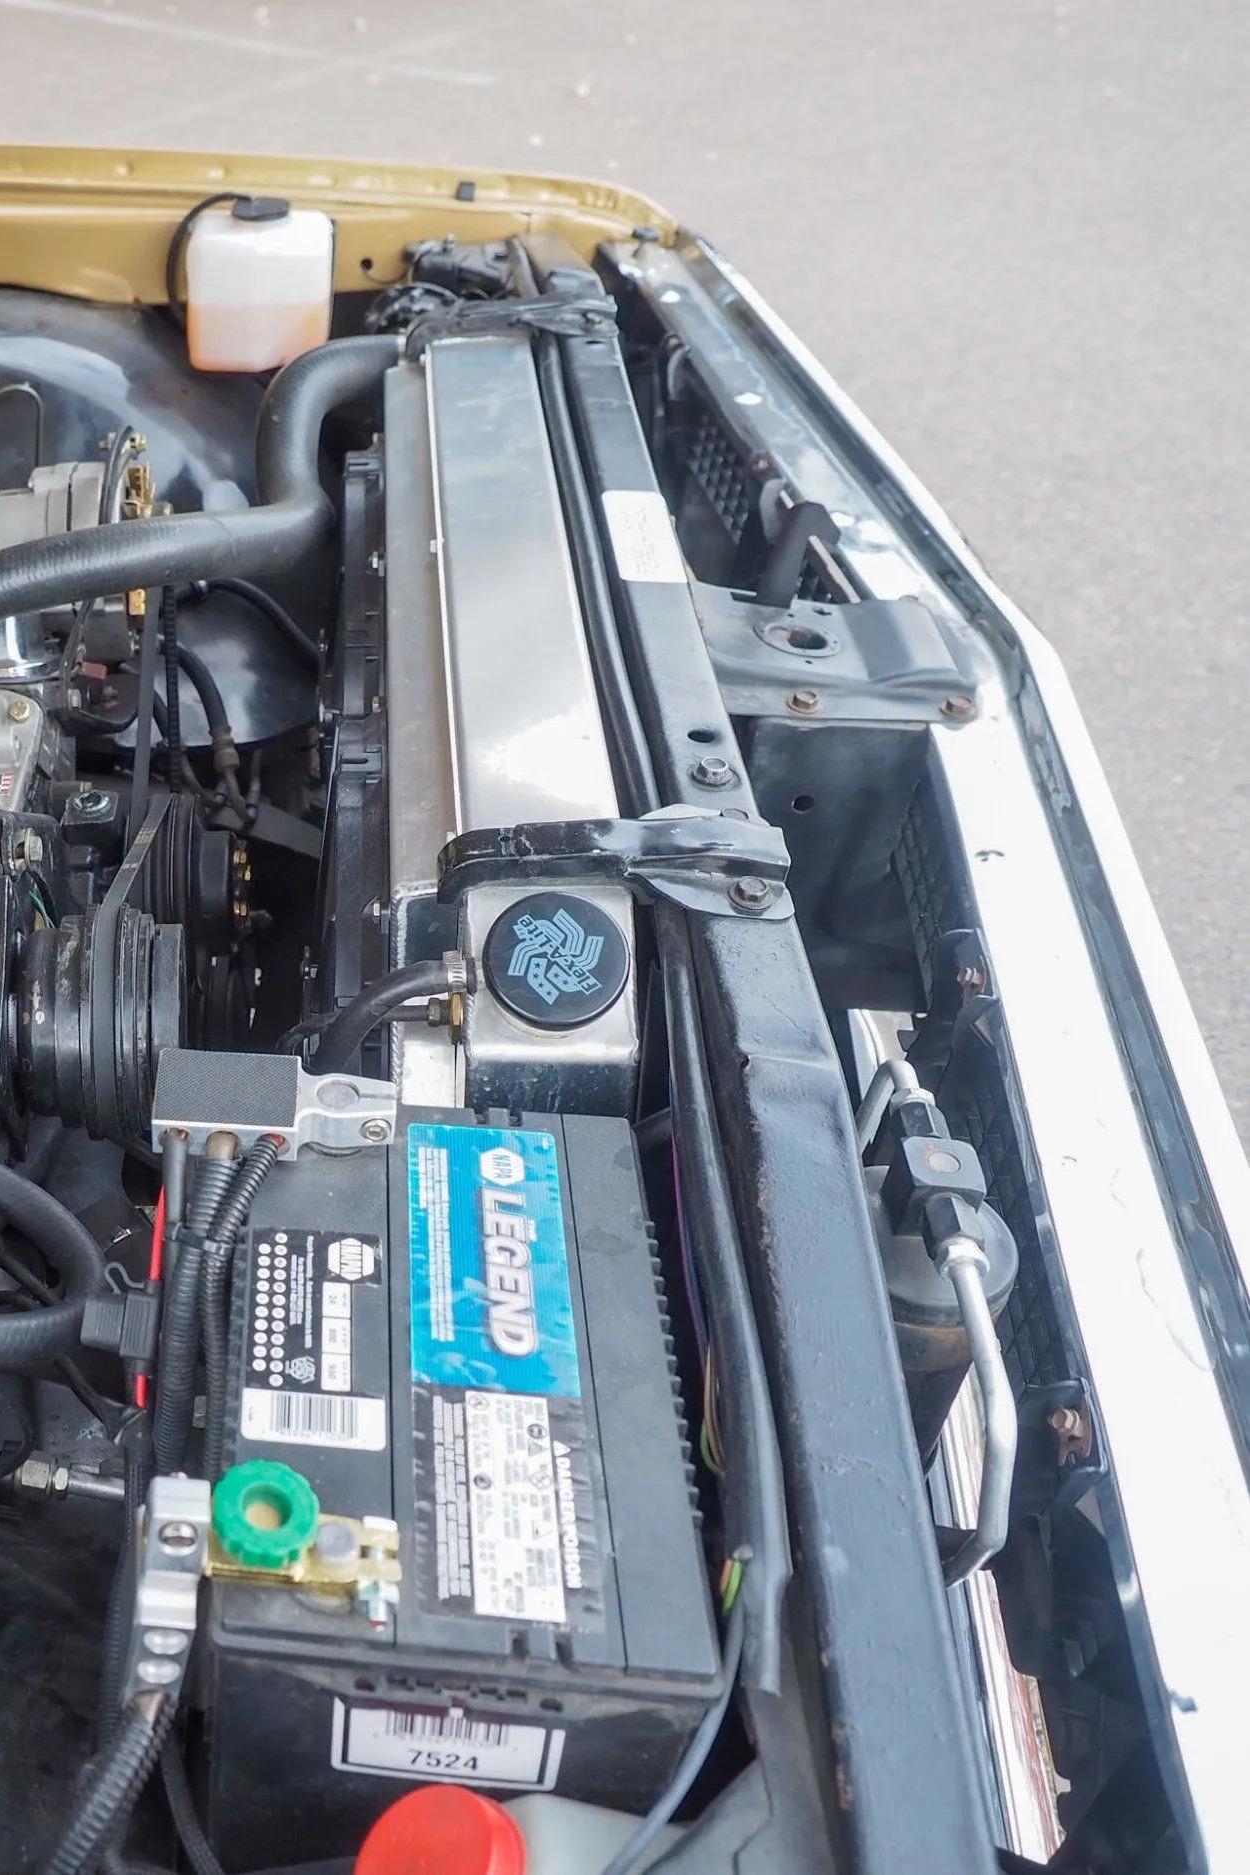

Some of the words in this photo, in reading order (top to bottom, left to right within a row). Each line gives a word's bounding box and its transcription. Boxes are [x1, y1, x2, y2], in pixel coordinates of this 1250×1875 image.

[519, 916, 598, 991] Flex-A-Lite
[492, 1153, 512, 1180] NAPA
[482, 1187, 537, 1357] LEGEND
[408, 1749, 479, 1771] 7524
